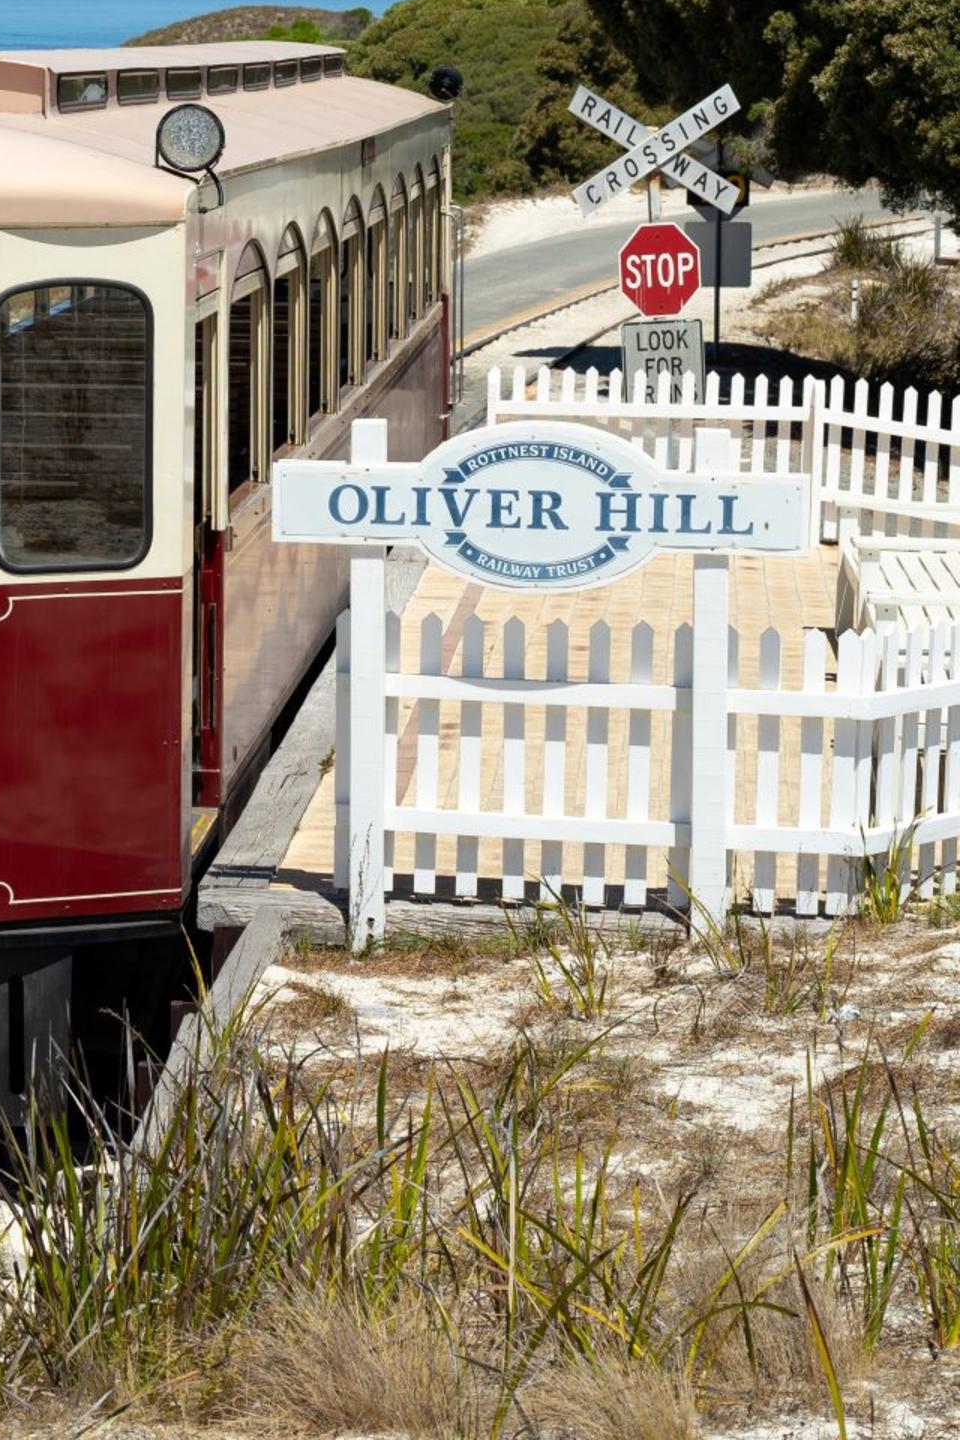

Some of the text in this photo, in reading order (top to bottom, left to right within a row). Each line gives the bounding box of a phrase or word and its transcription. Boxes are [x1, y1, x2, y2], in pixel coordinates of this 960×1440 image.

[580, 94, 729, 202] RAIL WAY
[585, 95, 729, 205] CROSSING
[625, 252, 694, 289] STOP
[636, 329, 689, 352] LOOK
[644, 356, 683, 379] FOR
[467, 444, 609, 477] ROTTNEST ISLAND
[328, 483, 754, 536] OLIVER HILL
[476, 553, 596, 579] RAILWAY TRUST
